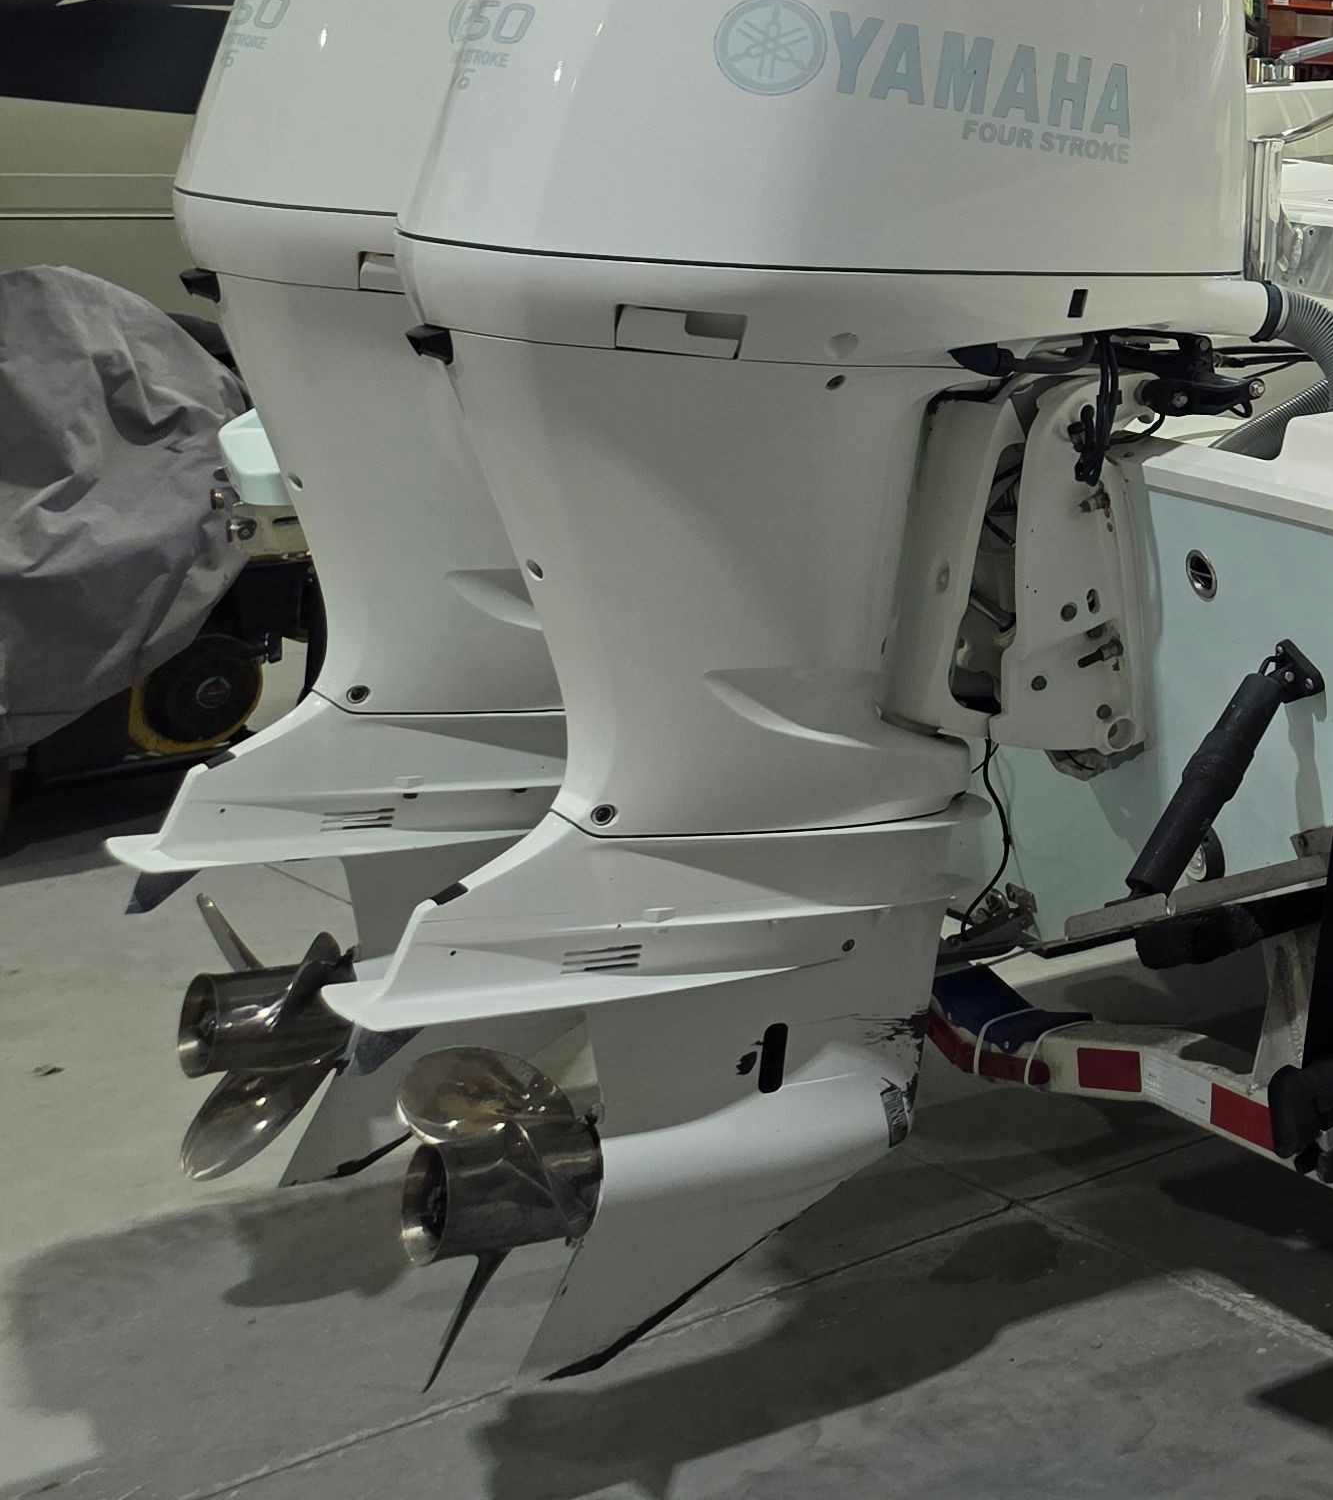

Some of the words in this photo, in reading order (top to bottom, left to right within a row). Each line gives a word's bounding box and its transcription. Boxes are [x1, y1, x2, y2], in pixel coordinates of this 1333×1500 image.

[830, 10, 1131, 139] YAMAHA
[961, 119, 1034, 150] FOUR
[1039, 131, 1131, 165] STROKE
